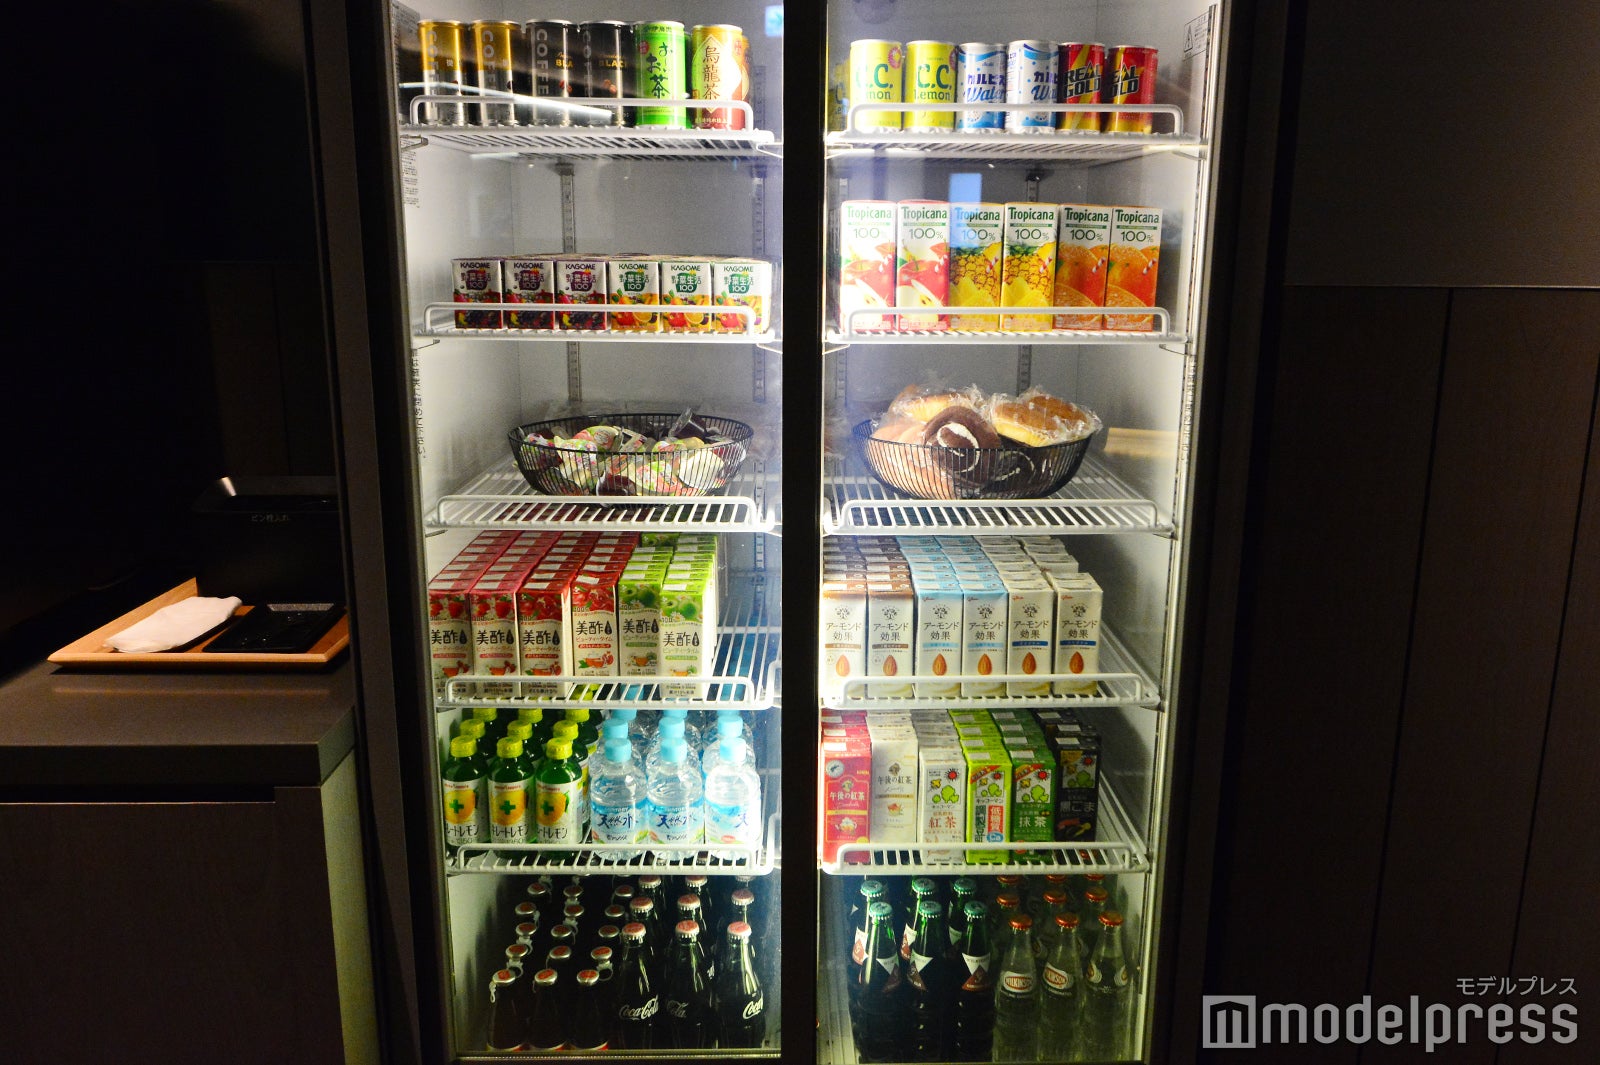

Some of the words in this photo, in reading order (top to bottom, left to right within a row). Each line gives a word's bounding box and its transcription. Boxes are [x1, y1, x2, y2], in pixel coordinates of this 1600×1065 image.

[702, 46, 720, 100] 烏龍茶
[916, 64, 953, 90] C.C.
[1063, 61, 1101, 83] REAL
[1063, 77, 1100, 99] GOLD
[847, 206, 892, 220] Tropicana
[901, 206, 947, 221] Tropicana
[955, 207, 1000, 222] Tropicana
[1008, 207, 1054, 222] Tropicana
[1064, 208, 1109, 223] Tropicana
[1115, 209, 1160, 224] Tropicana
[909, 228, 943, 240] 100%
[962, 229, 995, 241] 100%
[1015, 229, 1050, 241] 100%
[1070, 229, 1103, 241] 100%
[1121, 230, 1155, 243] 100%
[671, 264, 701, 272] KAGOME
[576, 620, 604, 636] 美酢
[623, 618, 651, 634] 美酢
[826, 622, 861, 631] アーモンド
[873, 622, 909, 632] アーモンド
[923, 621, 960, 631] アーモンド
[968, 621, 1004, 631] アーモンド
[1013, 620, 1049, 630] アーモンド
[1061, 620, 1098, 630] アーモンド
[431, 630, 458, 645] 美酢
[477, 630, 505, 645] 美酢
[523, 630, 552, 645] 美酢
[663, 631, 691, 647] 美酢
[833, 631, 853, 642] 効果
[880, 631, 901, 642] 効果
[930, 631, 951, 641] 効果
[975, 631, 996, 641] 効果
[1020, 629, 1041, 640] 効果
[1068, 629, 1089, 640] 効果
[877, 775, 912, 785] 午後の紅茶
[829, 791, 865, 801] 午後の紅茶
[597, 812, 639, 829] 天然水
[928, 816, 957, 829] 紅茶
[1018, 816, 1047, 828] 抹茶
